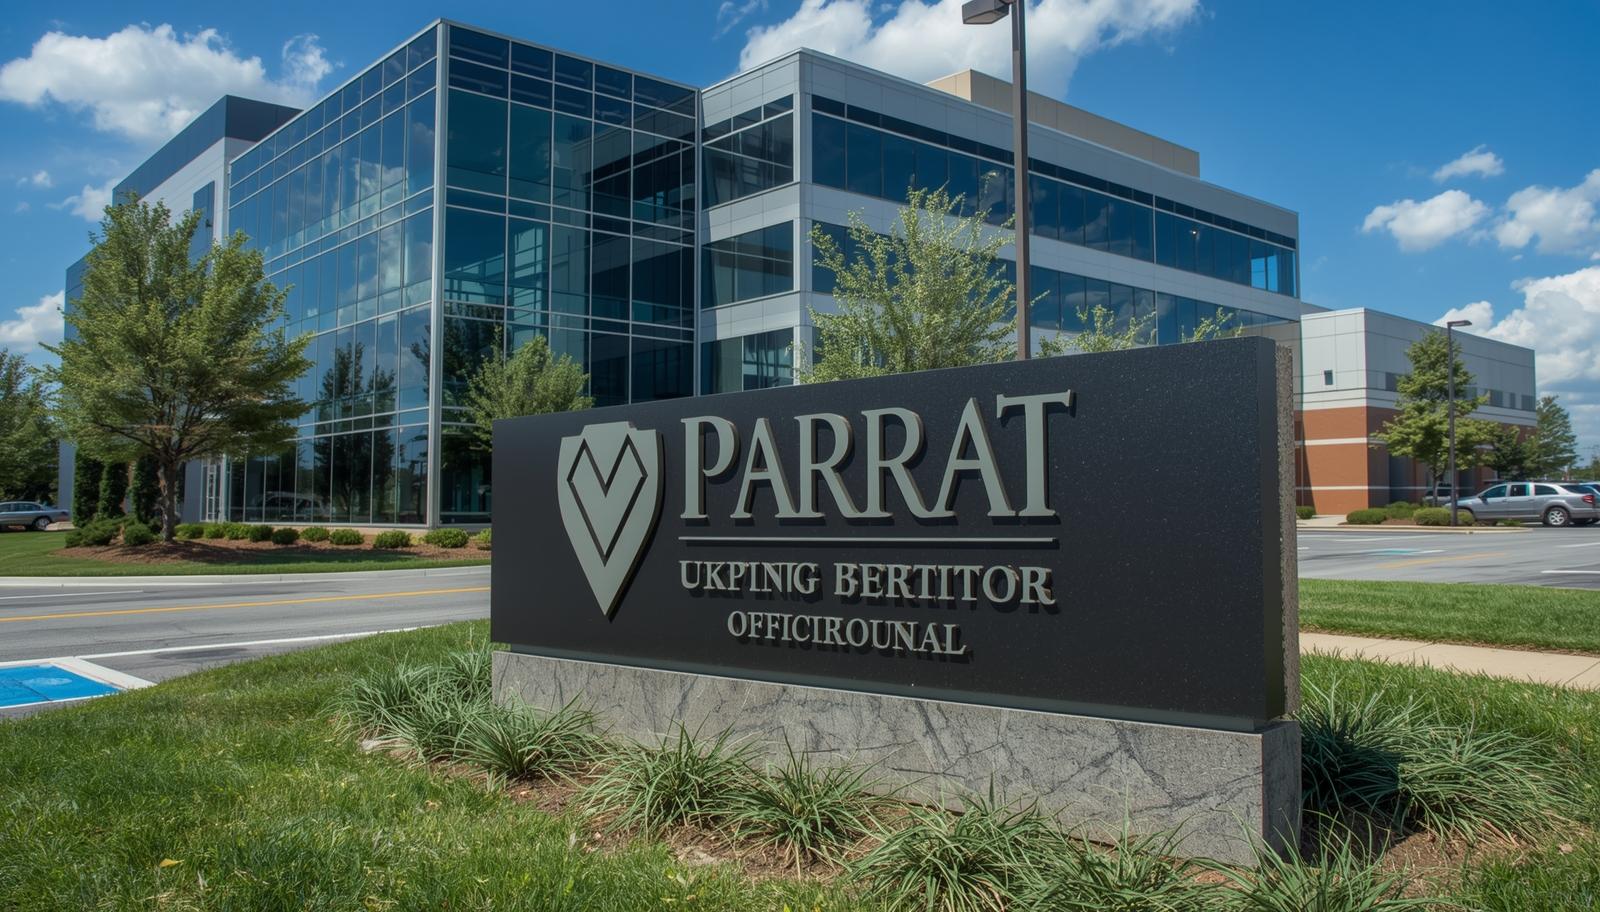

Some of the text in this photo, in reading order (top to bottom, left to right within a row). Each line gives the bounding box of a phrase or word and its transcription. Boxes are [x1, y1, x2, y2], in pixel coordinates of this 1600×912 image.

[680, 389, 1073, 519] PARRAT
[833, 562, 1055, 605] BERTITOR
[727, 610, 967, 655] OFFICIROUNAL
